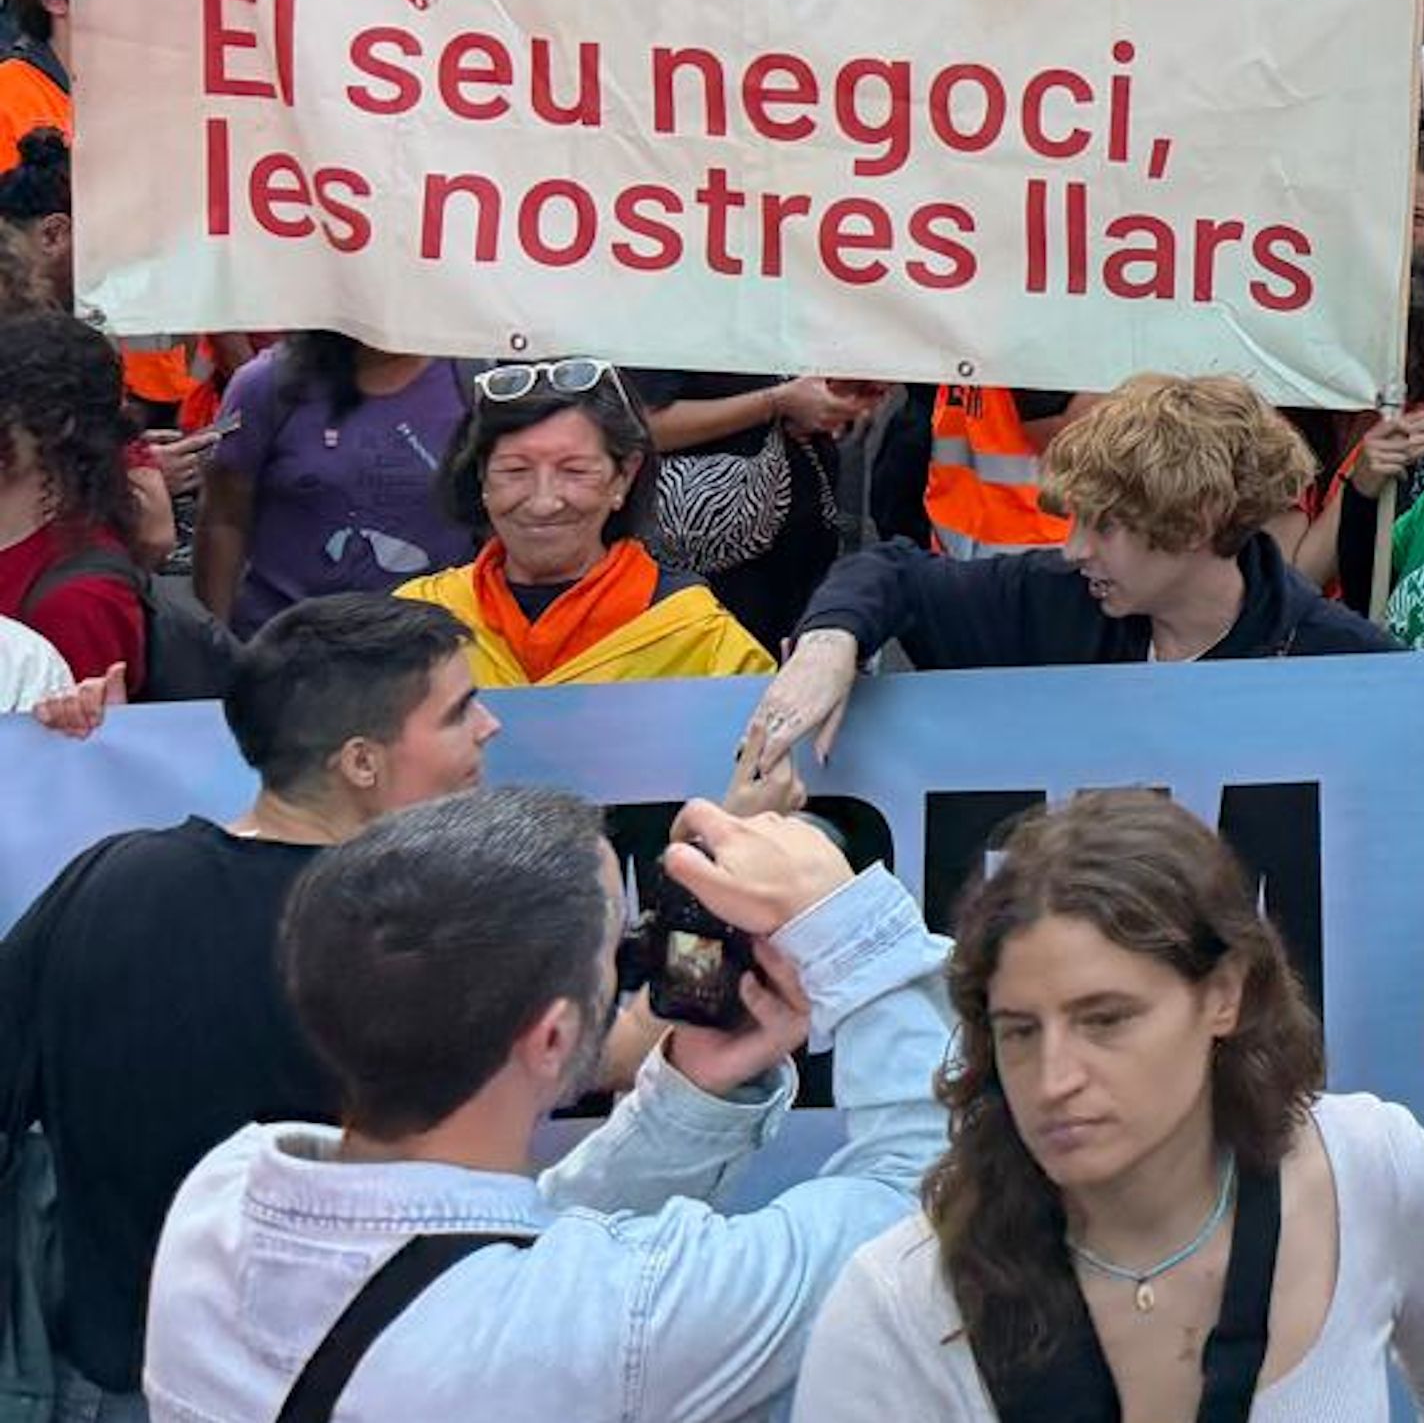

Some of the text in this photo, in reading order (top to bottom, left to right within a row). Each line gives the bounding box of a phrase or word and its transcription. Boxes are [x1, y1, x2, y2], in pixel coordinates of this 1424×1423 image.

[346, 28, 602, 127] seu
[652, 41, 1171, 180] negoci,
[205, 118, 1313, 310] les nostres llars
